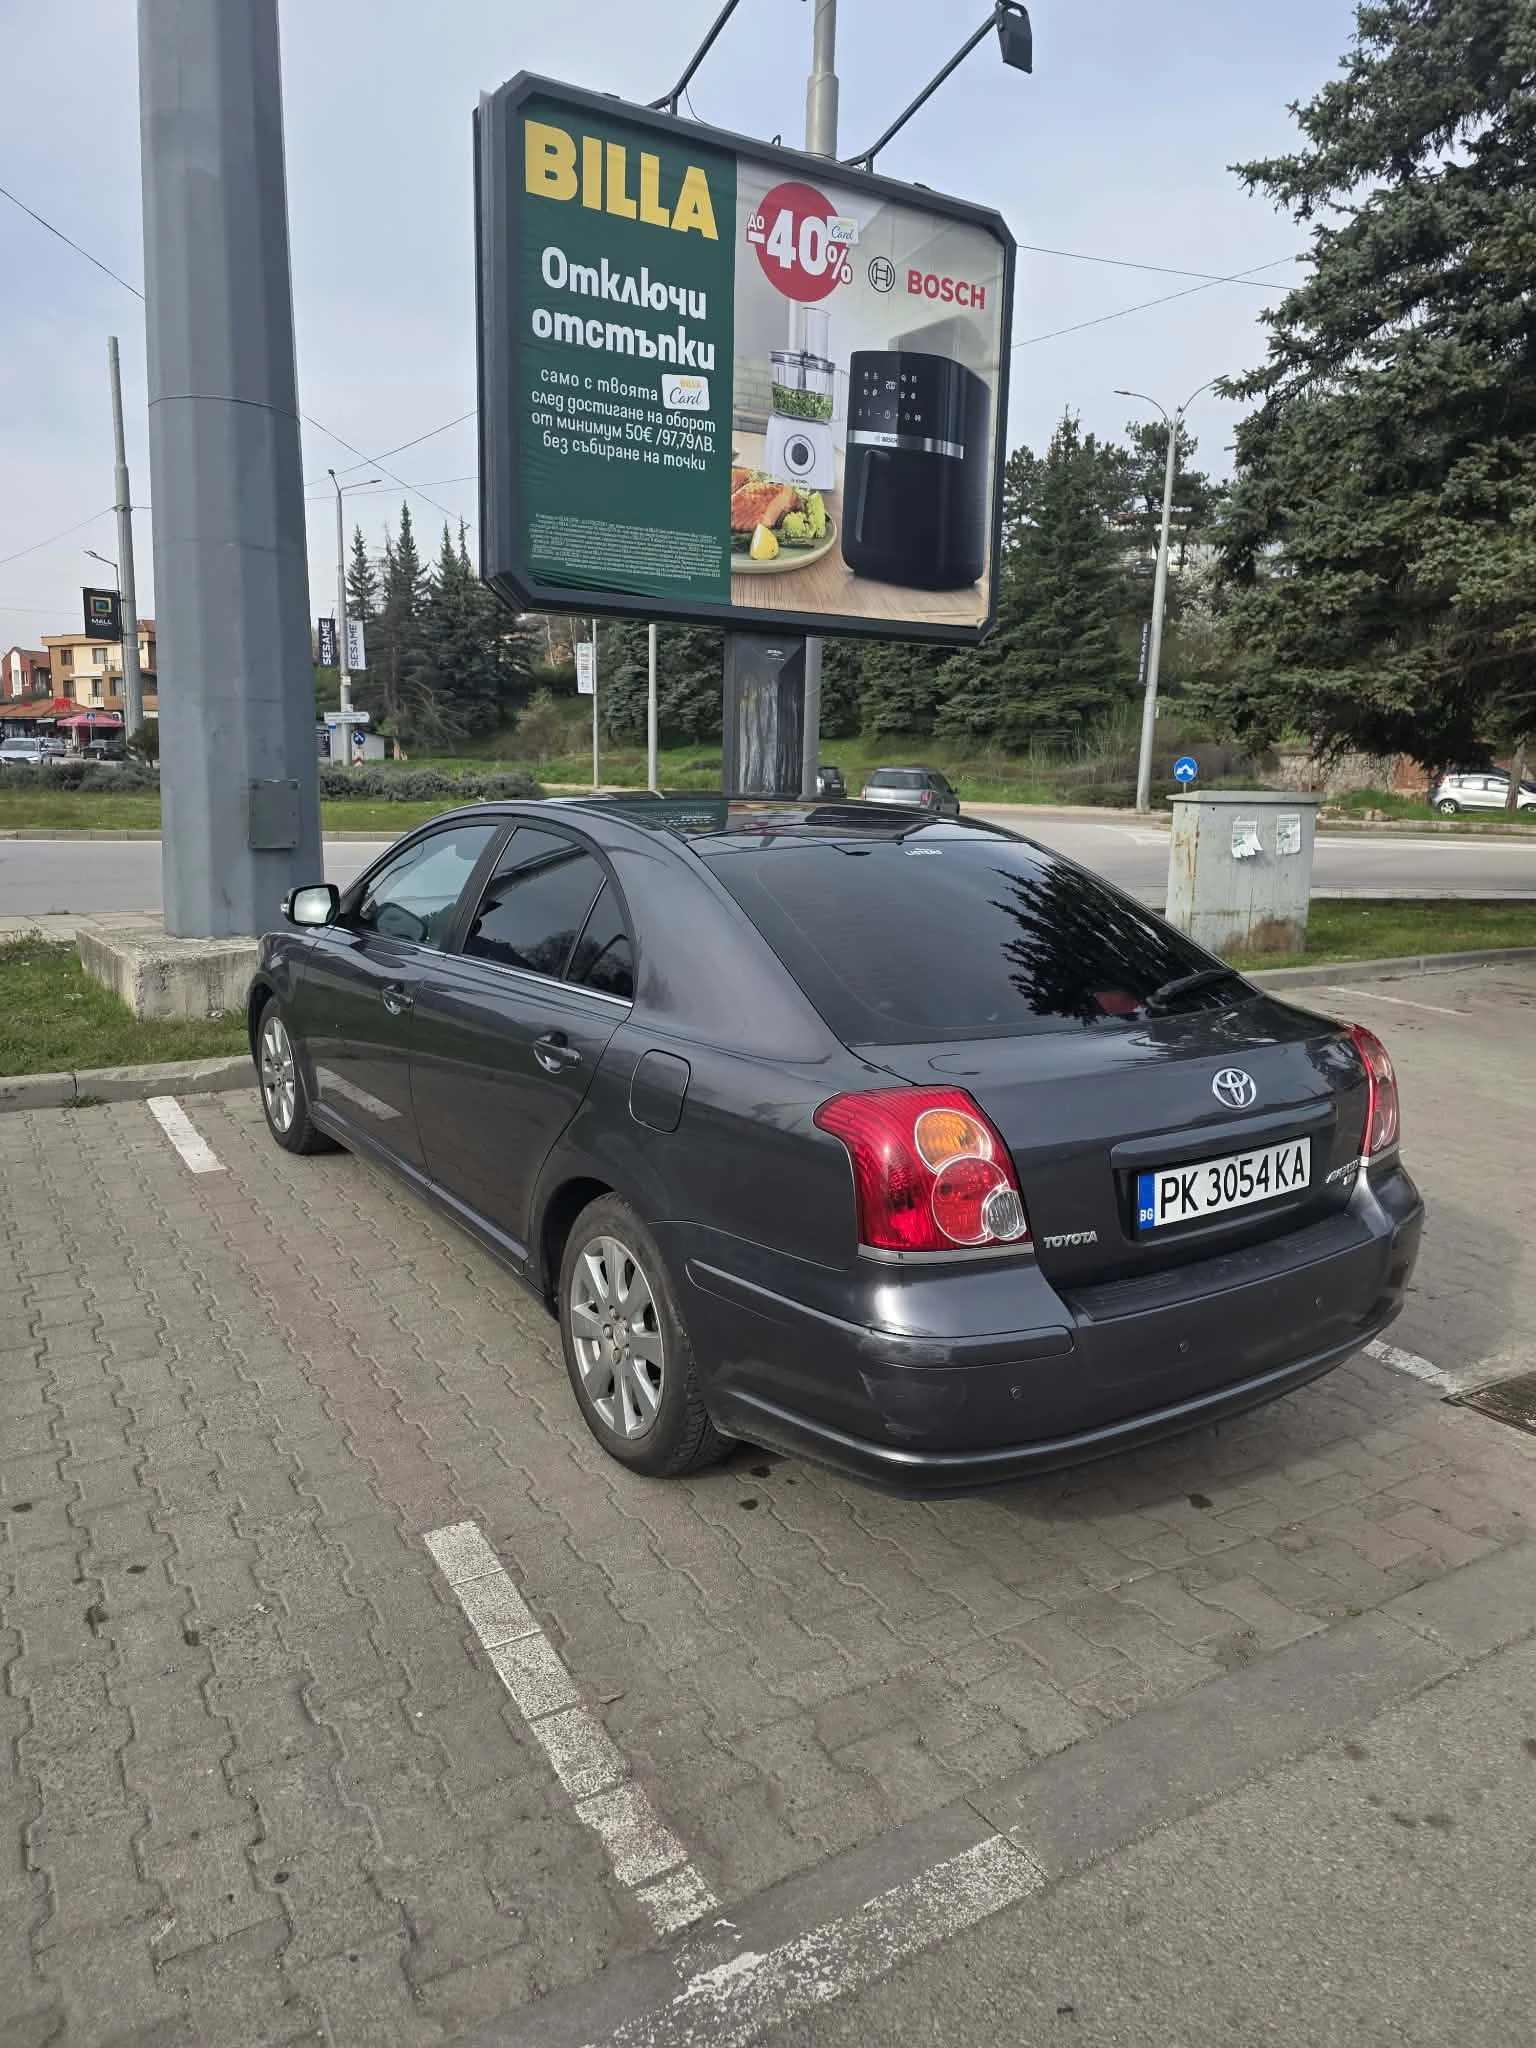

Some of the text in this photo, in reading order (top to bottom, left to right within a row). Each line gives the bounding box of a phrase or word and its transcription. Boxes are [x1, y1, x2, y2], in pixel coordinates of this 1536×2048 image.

[524, 119, 719, 241] BILLA
[541, 246, 707, 321] Отключи
[907, 269, 986, 310] BOSCH
[531, 308, 715, 371] отстъпки
[540, 368, 579, 387] само
[584, 377, 592, 390] с
[597, 377, 658, 401] твоята
[669, 386, 702, 405] Card
[531, 390, 716, 433] след достигане на оборот
[531, 412, 552, 427] от
[556, 415, 622, 441] минимум
[625, 423, 653, 443] 50€
[543, 430, 706, 471] без събиране на точки
[321, 620, 332, 665] SESAME
[349, 623, 359, 667] SESAME
[1160, 1171, 1199, 1219] PK
[1206, 1154, 1270, 1207] 3054
[1275, 1146, 1305, 1190] KA
[1139, 1207, 1154, 1223] BG
[1042, 1230, 1098, 1249] TOYOTA
